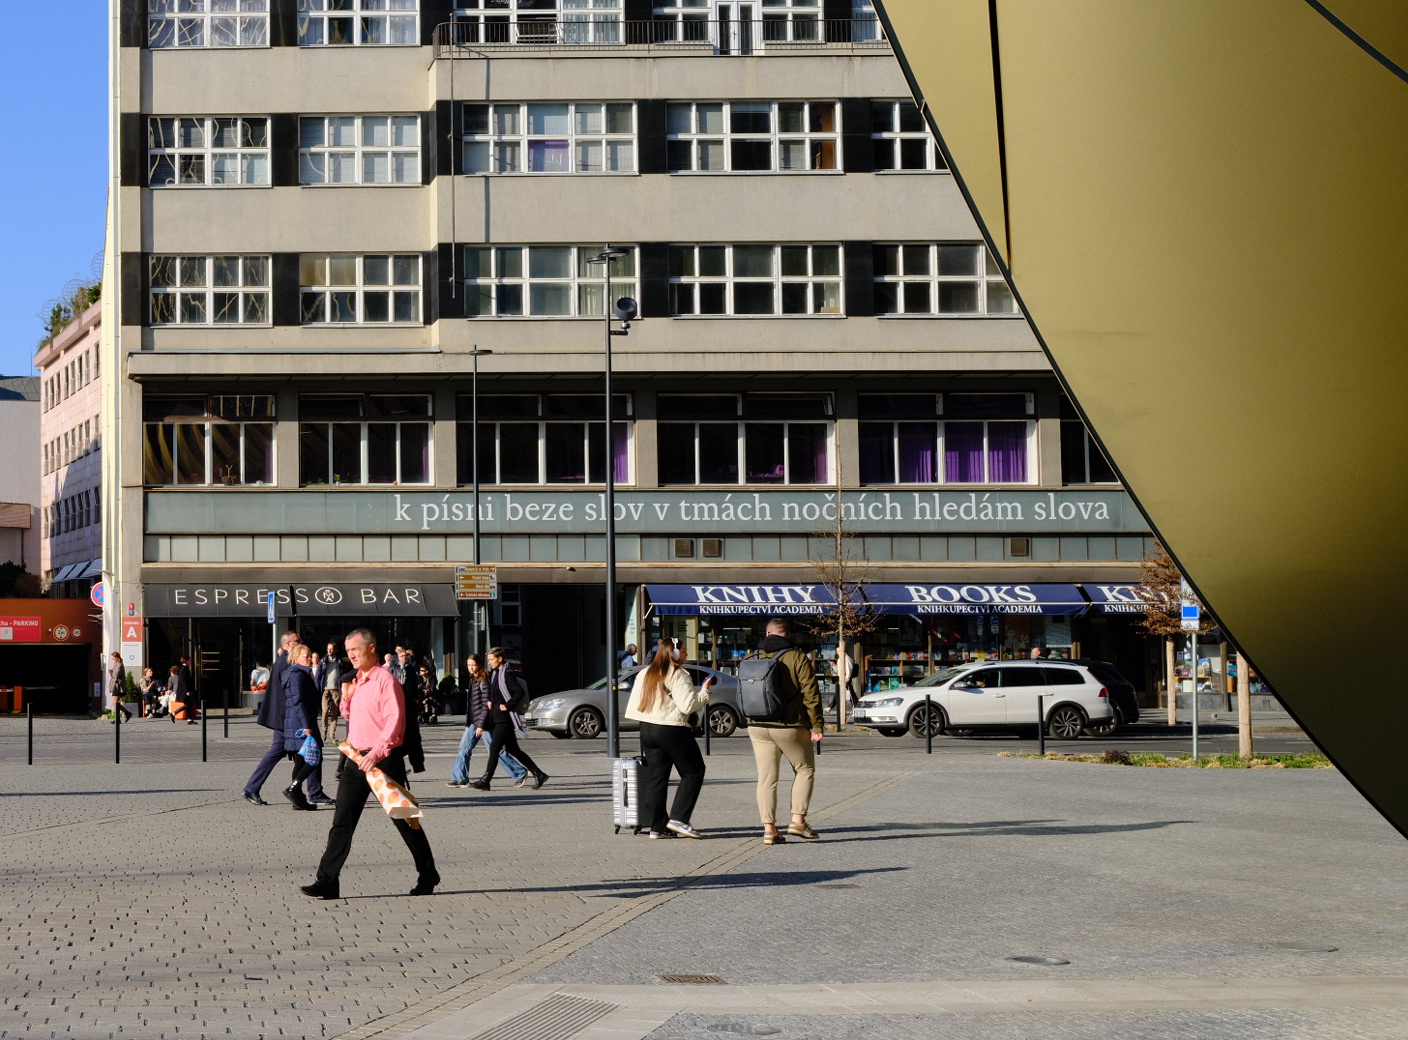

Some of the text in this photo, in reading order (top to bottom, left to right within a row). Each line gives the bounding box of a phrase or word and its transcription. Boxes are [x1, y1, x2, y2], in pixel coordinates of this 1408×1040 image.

[394, 493, 1110, 530] k písni beze slov v tmách nočních hledám slova
[175, 586, 421, 605] ESPRESSO BAR
[691, 585, 816, 603] KNIHY
[904, 585, 1037, 603] BOOKS
[699, 604, 824, 614] KNIHKUPECTVÍ ACADEMIA
[917, 604, 1043, 614] KNIHKUPECTVÍ ACADEMIA
[126, 626, 138, 638] A
